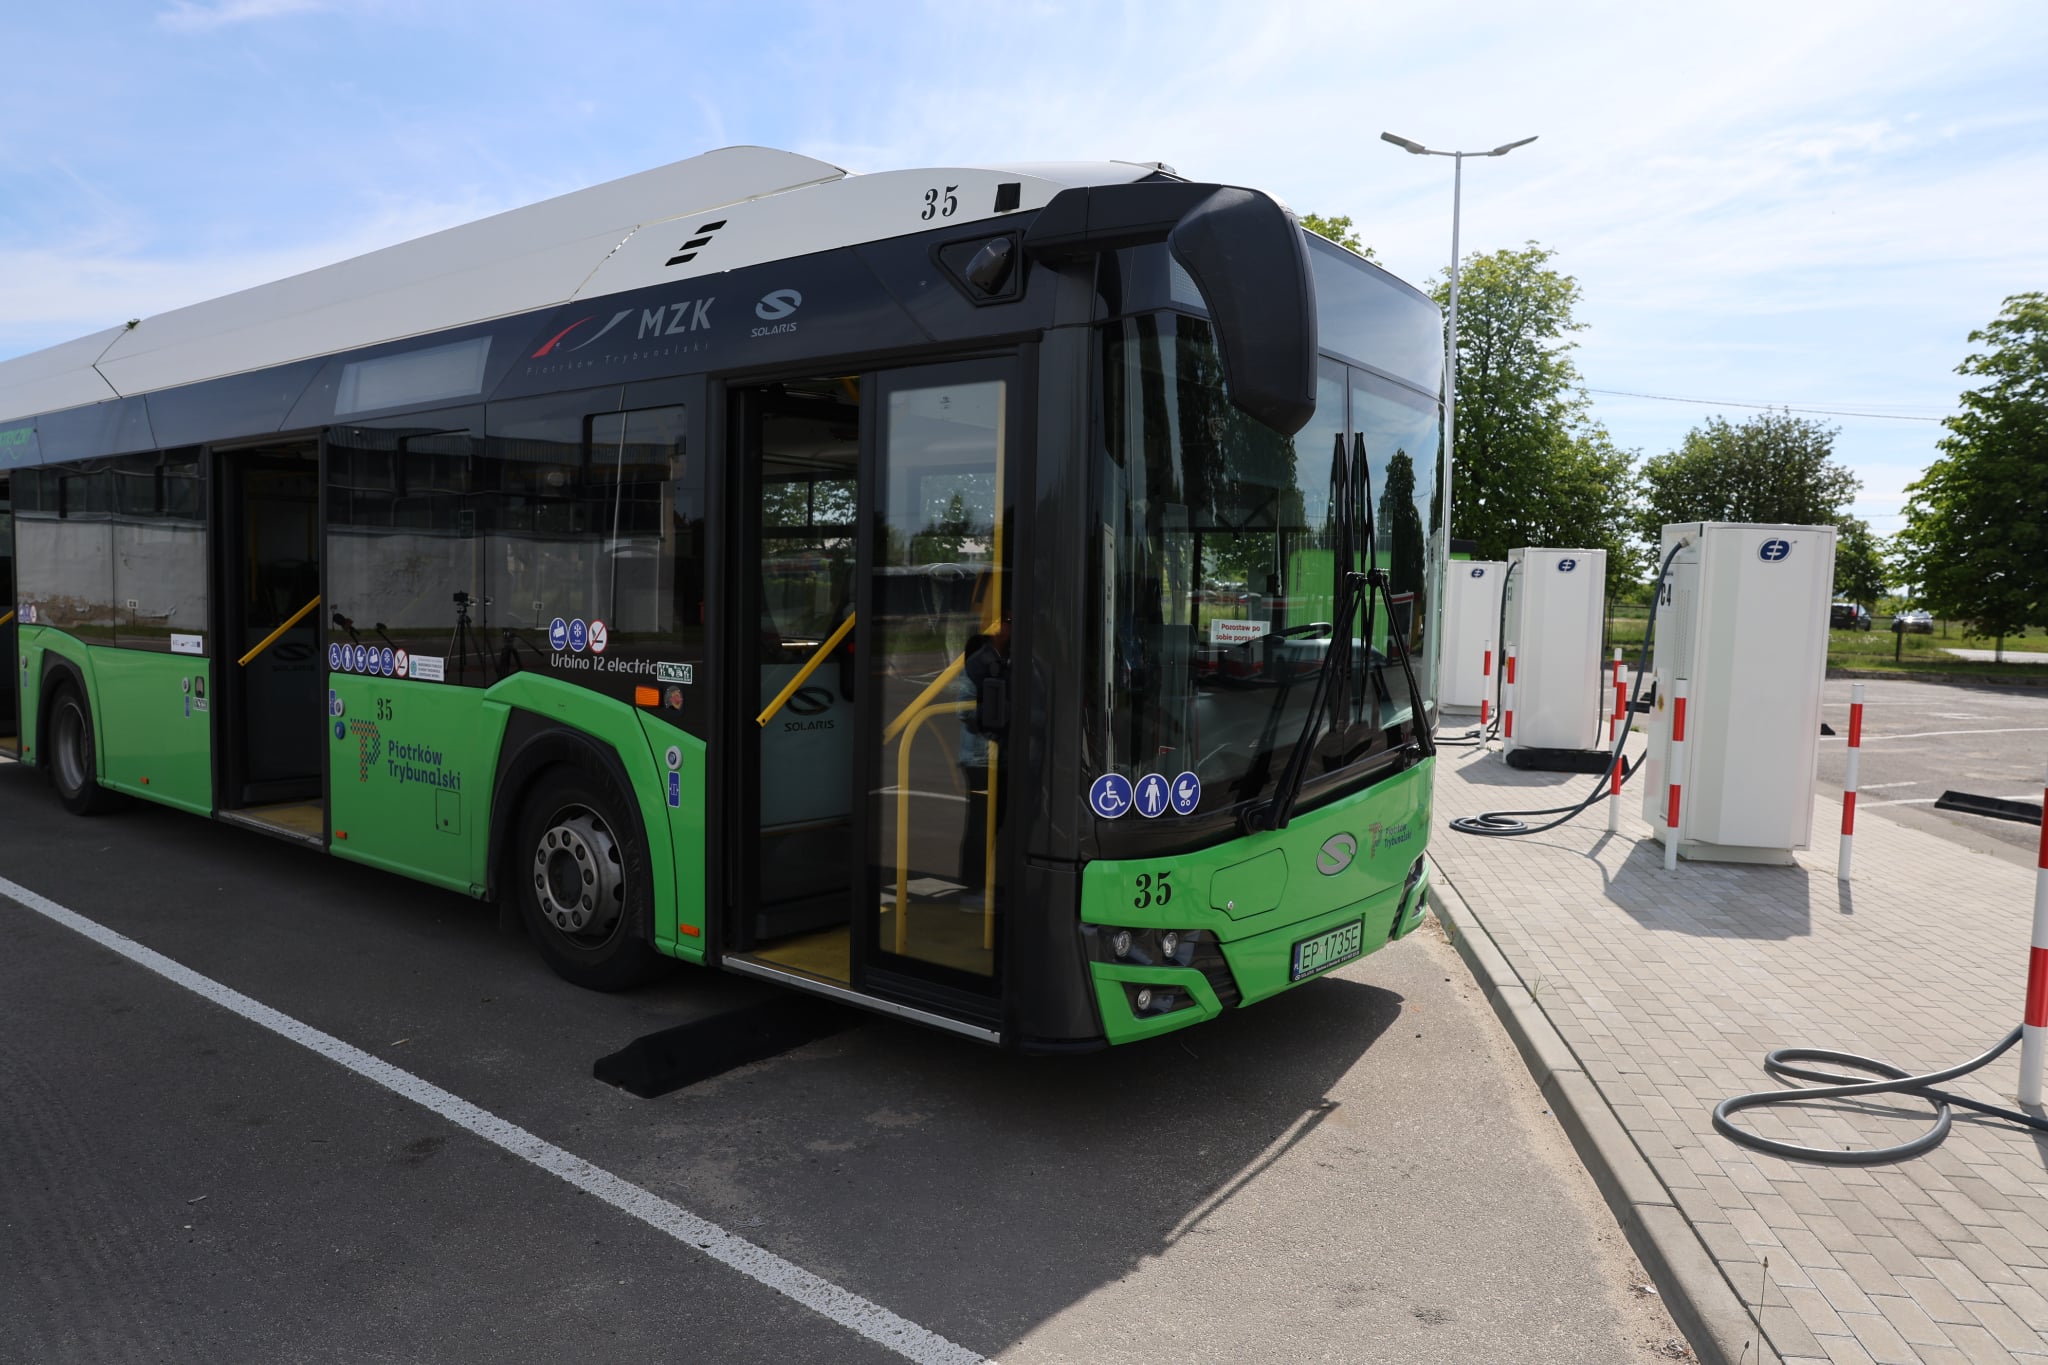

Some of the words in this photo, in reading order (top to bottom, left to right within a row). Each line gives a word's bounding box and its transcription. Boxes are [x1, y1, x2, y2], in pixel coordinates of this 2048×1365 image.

[921, 185, 959, 220] 35
[637, 297, 716, 339] MZK
[751, 322, 797, 337] SOLARIS
[605, 343, 710, 364] Trybunalski
[1216, 633, 1233, 641] sobie
[1221, 623, 1251, 632] Pozostaw
[551, 653, 590, 670] Urbino
[593, 655, 606, 672] 12
[607, 657, 657, 675] electric
[377, 698, 393, 721] 35
[784, 720, 834, 732] SOLARIS
[388, 740, 443, 766] Piotrków
[387, 759, 461, 790] Trybunalski
[1134, 870, 1172, 909] 35
[1302, 941, 1319, 970] EP
[1324, 925, 1359, 961] 1735E
